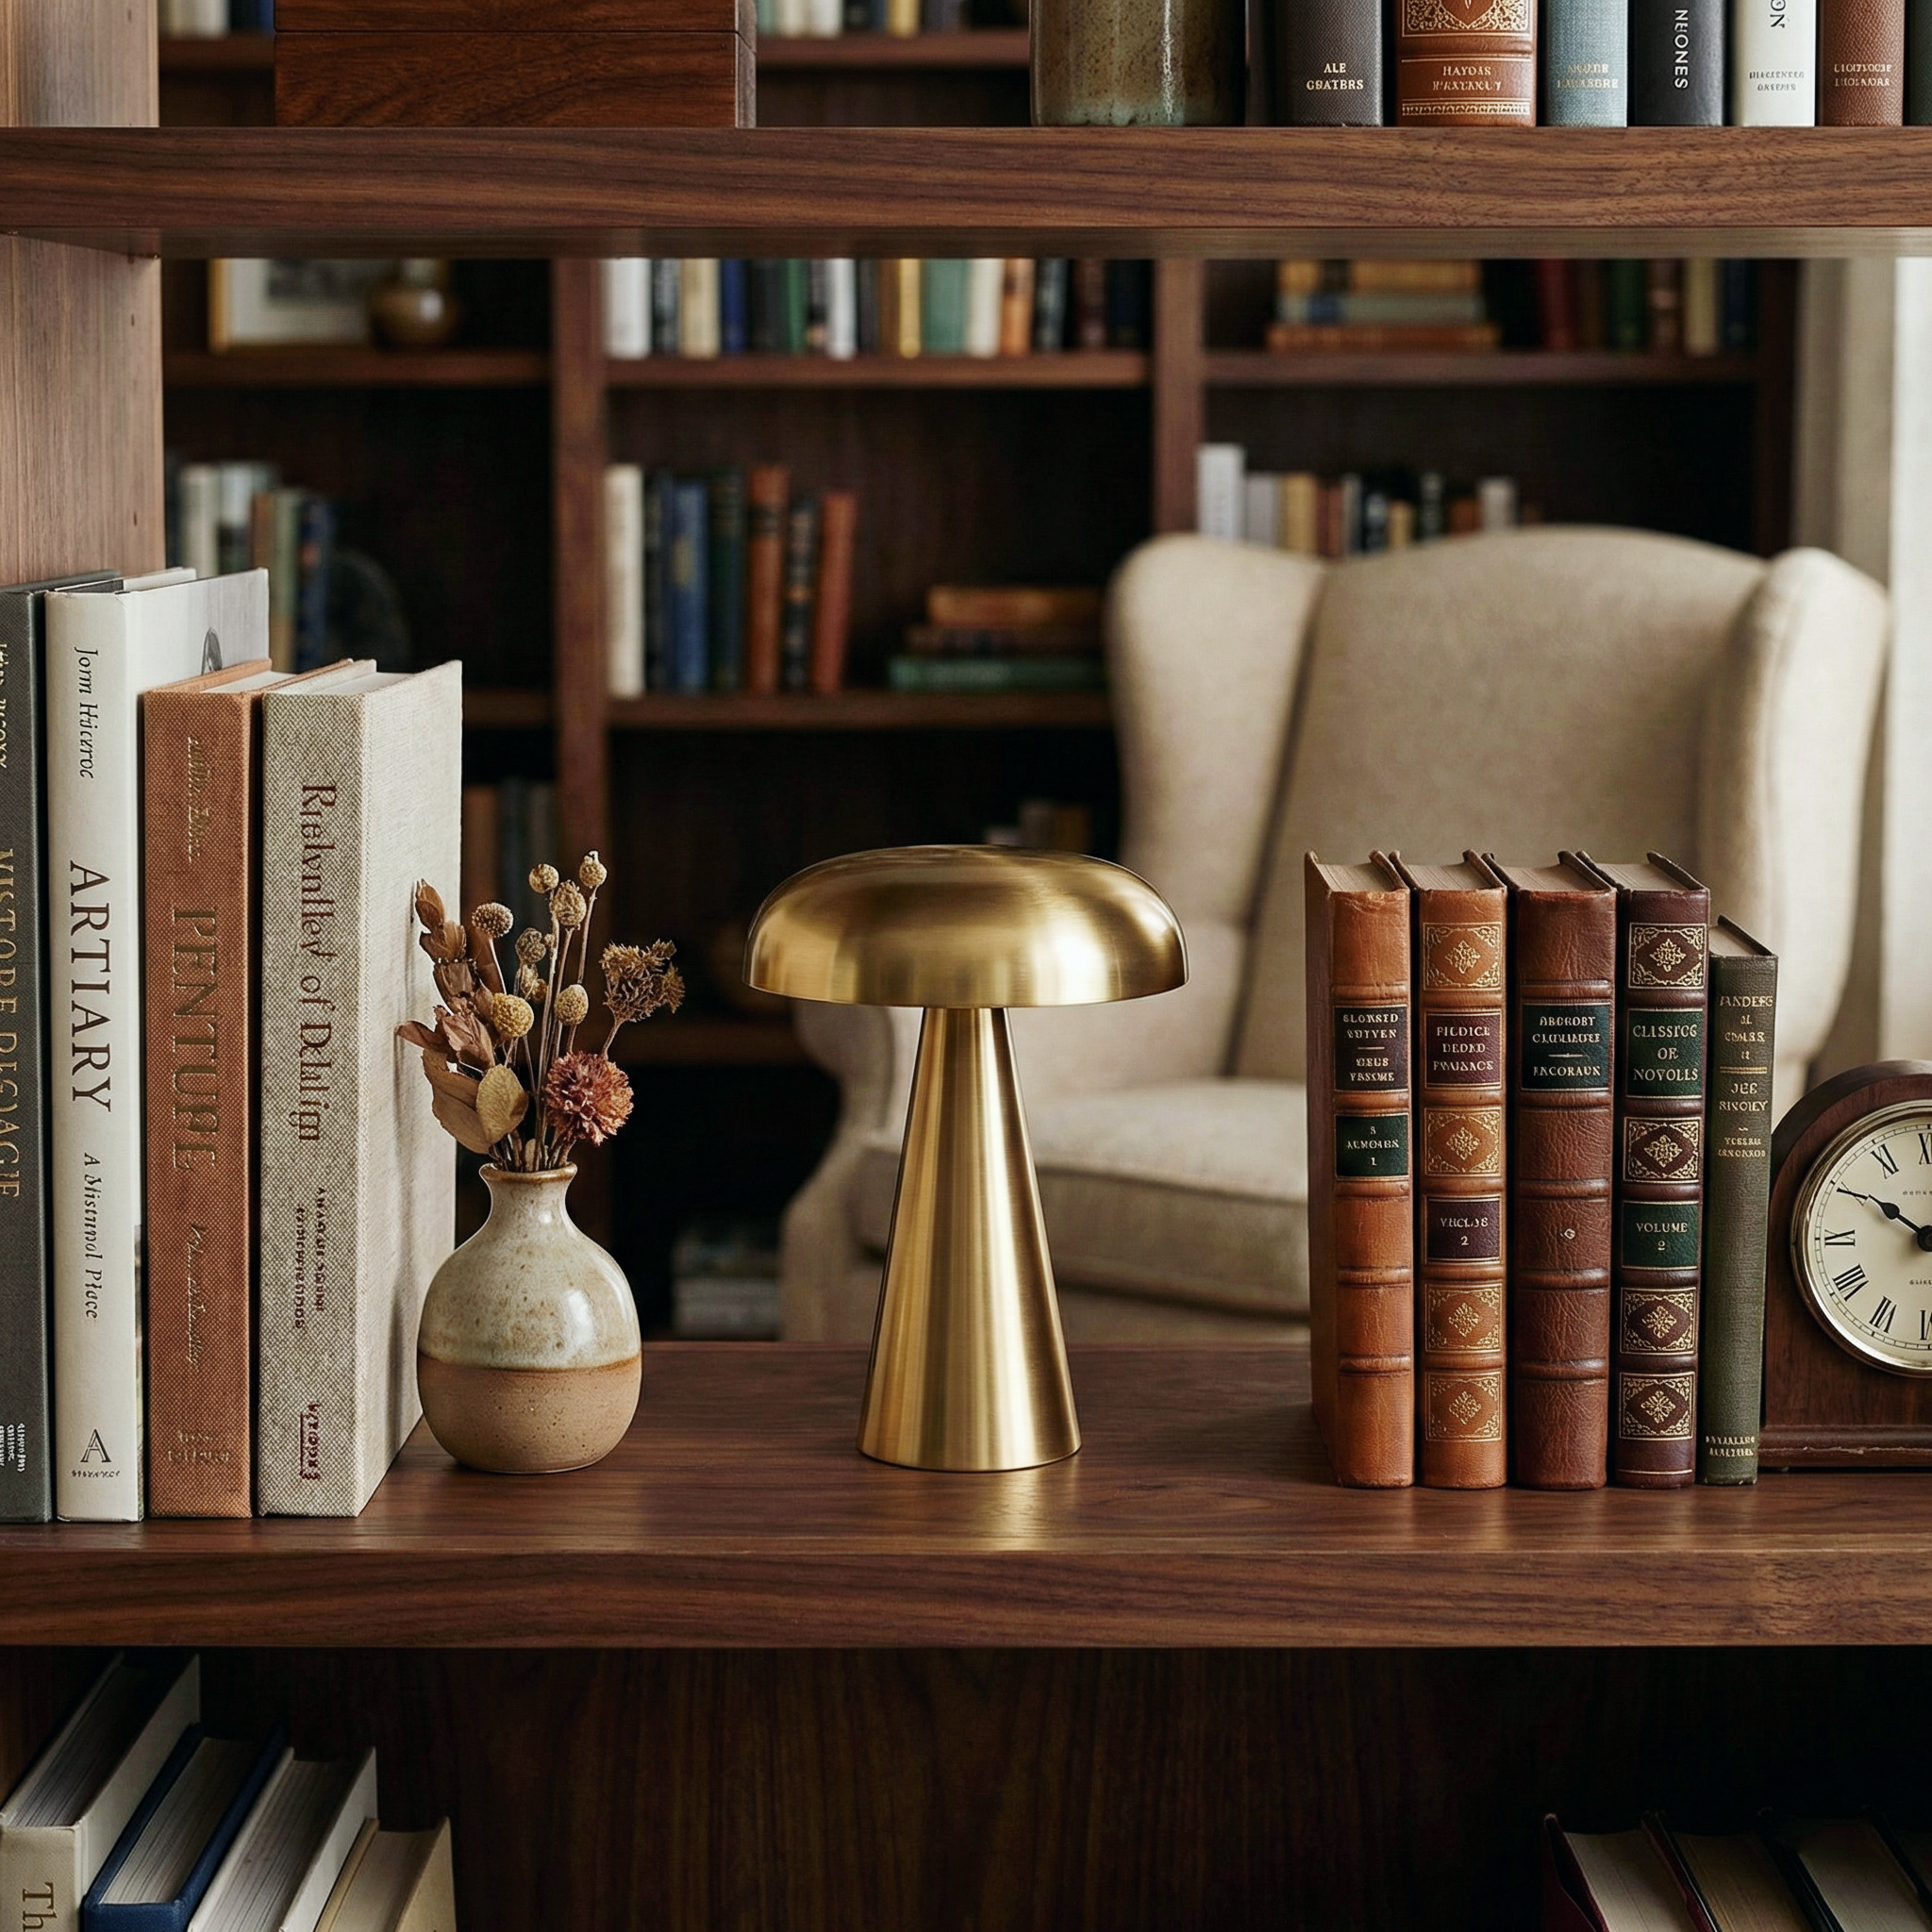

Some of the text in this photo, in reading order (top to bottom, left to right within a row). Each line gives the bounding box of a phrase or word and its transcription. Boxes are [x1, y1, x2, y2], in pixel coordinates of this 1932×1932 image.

[1324, 62, 1346, 74] ALE
[70, 859, 111, 1113] ARTIARY
[1636, 1222, 1688, 1233] VOLUME
[1460, 1235, 1470, 1246] 2
[80, 1428, 111, 1463] A
